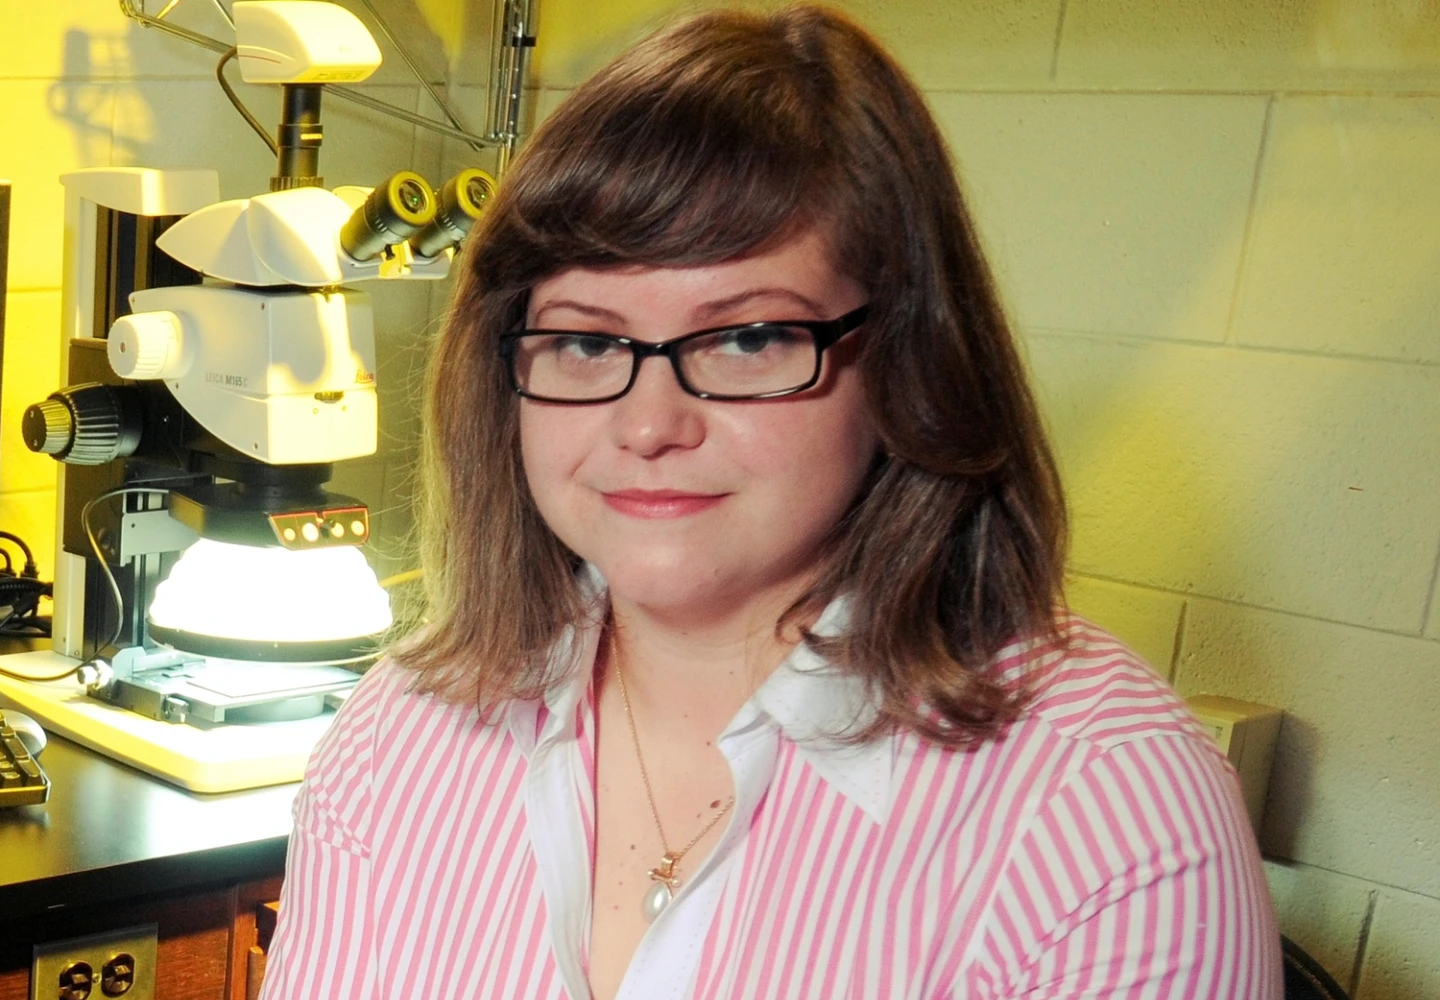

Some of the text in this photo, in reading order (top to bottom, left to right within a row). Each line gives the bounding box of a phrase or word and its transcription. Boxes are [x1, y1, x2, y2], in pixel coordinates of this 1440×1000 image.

[205, 372, 248, 388] LEICA M165 C
